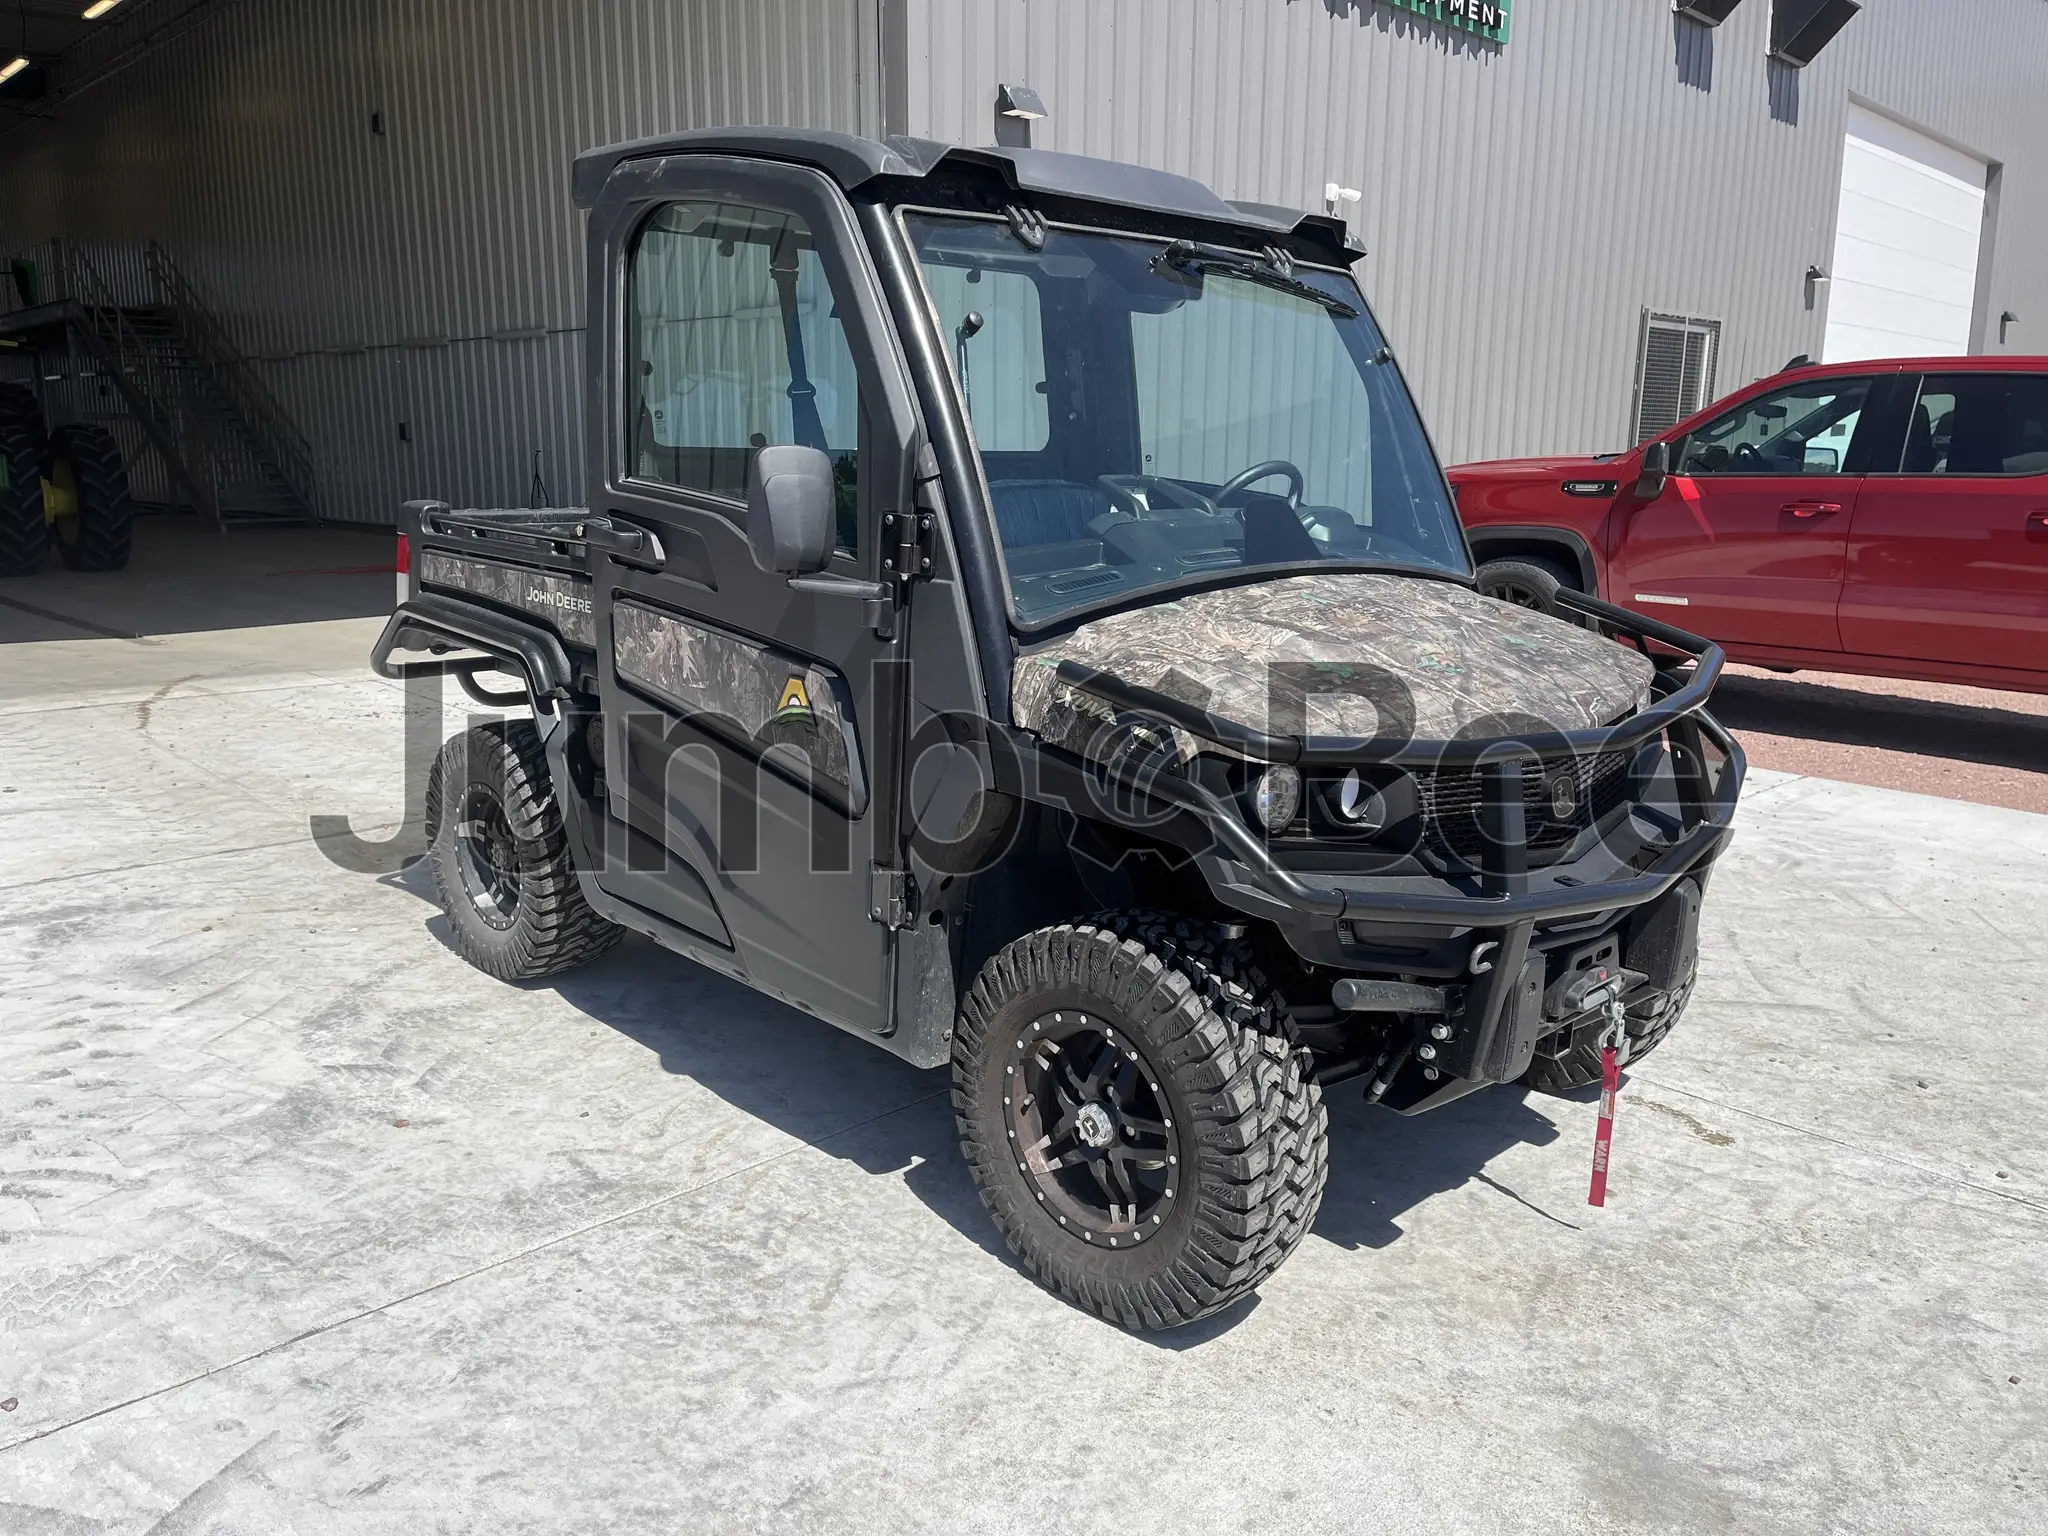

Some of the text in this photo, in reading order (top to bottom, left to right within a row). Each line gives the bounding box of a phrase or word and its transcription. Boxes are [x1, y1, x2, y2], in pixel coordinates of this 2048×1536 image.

[1426, 0, 1507, 29] MENT
[527, 586, 592, 614] JOHN DEERE
[1594, 1139, 1609, 1173] WARN
